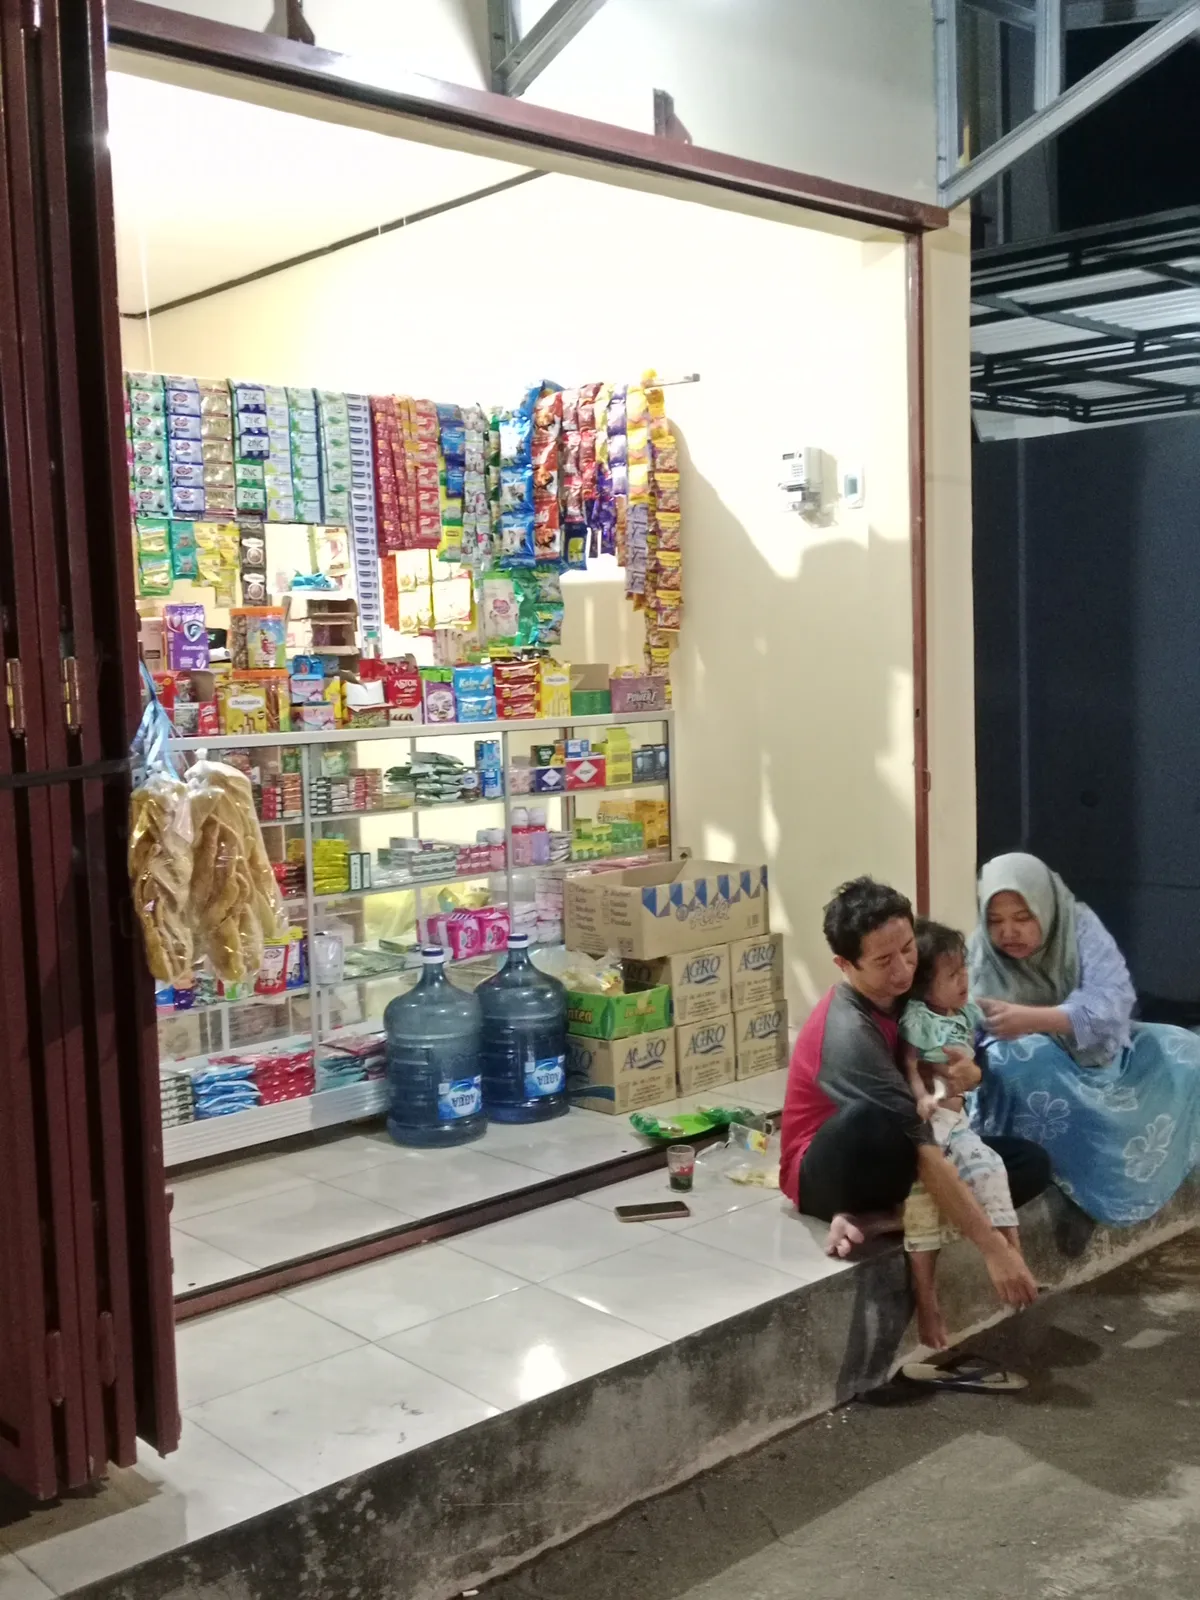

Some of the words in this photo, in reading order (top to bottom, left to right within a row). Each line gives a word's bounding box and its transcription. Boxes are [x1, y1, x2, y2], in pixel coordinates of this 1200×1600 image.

[679, 955, 721, 985] AGRO
[737, 943, 776, 973] AGRO
[684, 1025, 726, 1058] AGRO
[742, 1011, 781, 1043] AGRO
[536, 1072, 560, 1086] AQUA
[451, 1092, 475, 1108] AQUA
